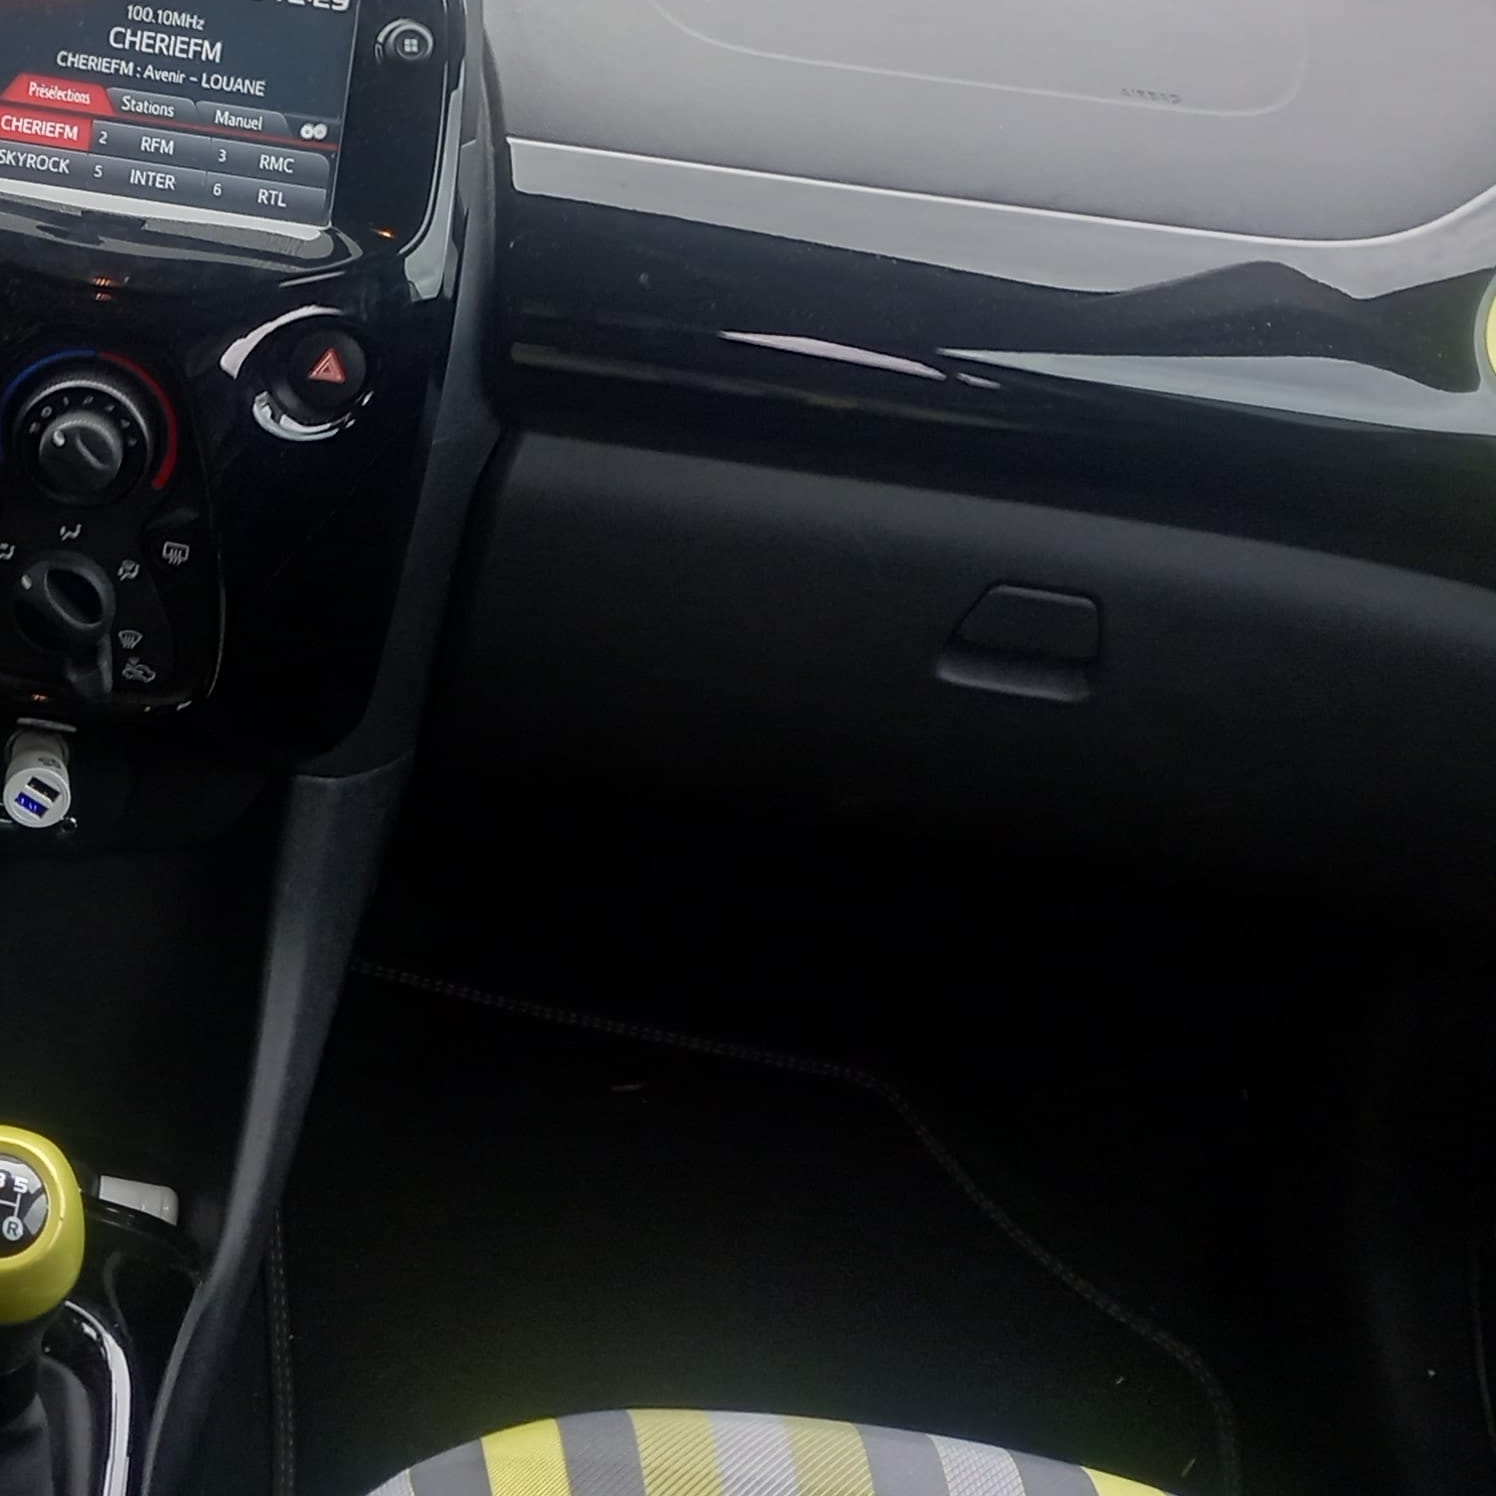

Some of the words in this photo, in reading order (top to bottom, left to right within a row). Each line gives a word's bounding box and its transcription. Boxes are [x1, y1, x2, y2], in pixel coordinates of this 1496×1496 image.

[127, 4, 205, 31] 100.10MHz
[109, 27, 223, 64] CHERIEFM
[56, 51, 134, 77] CHERIEFM
[144, 65, 186, 84] Avenir
[201, 73, 266, 96] LOUANE
[121, 96, 175, 118] Stations
[0, 115, 78, 141] CHERIEFM
[214, 110, 263, 131] Manuel
[99, 131, 108, 144] 2
[141, 136, 174, 155] RFM
[218, 149, 227, 163] 3
[259, 155, 295, 174] RMC
[94, 165, 103, 178] 5
[130, 169, 175, 191] INTER
[213, 183, 222, 196] 6
[257, 188, 287, 207] RTL
[13, 1177, 29, 1194] 5
[6, 1221, 19, 1237] R
